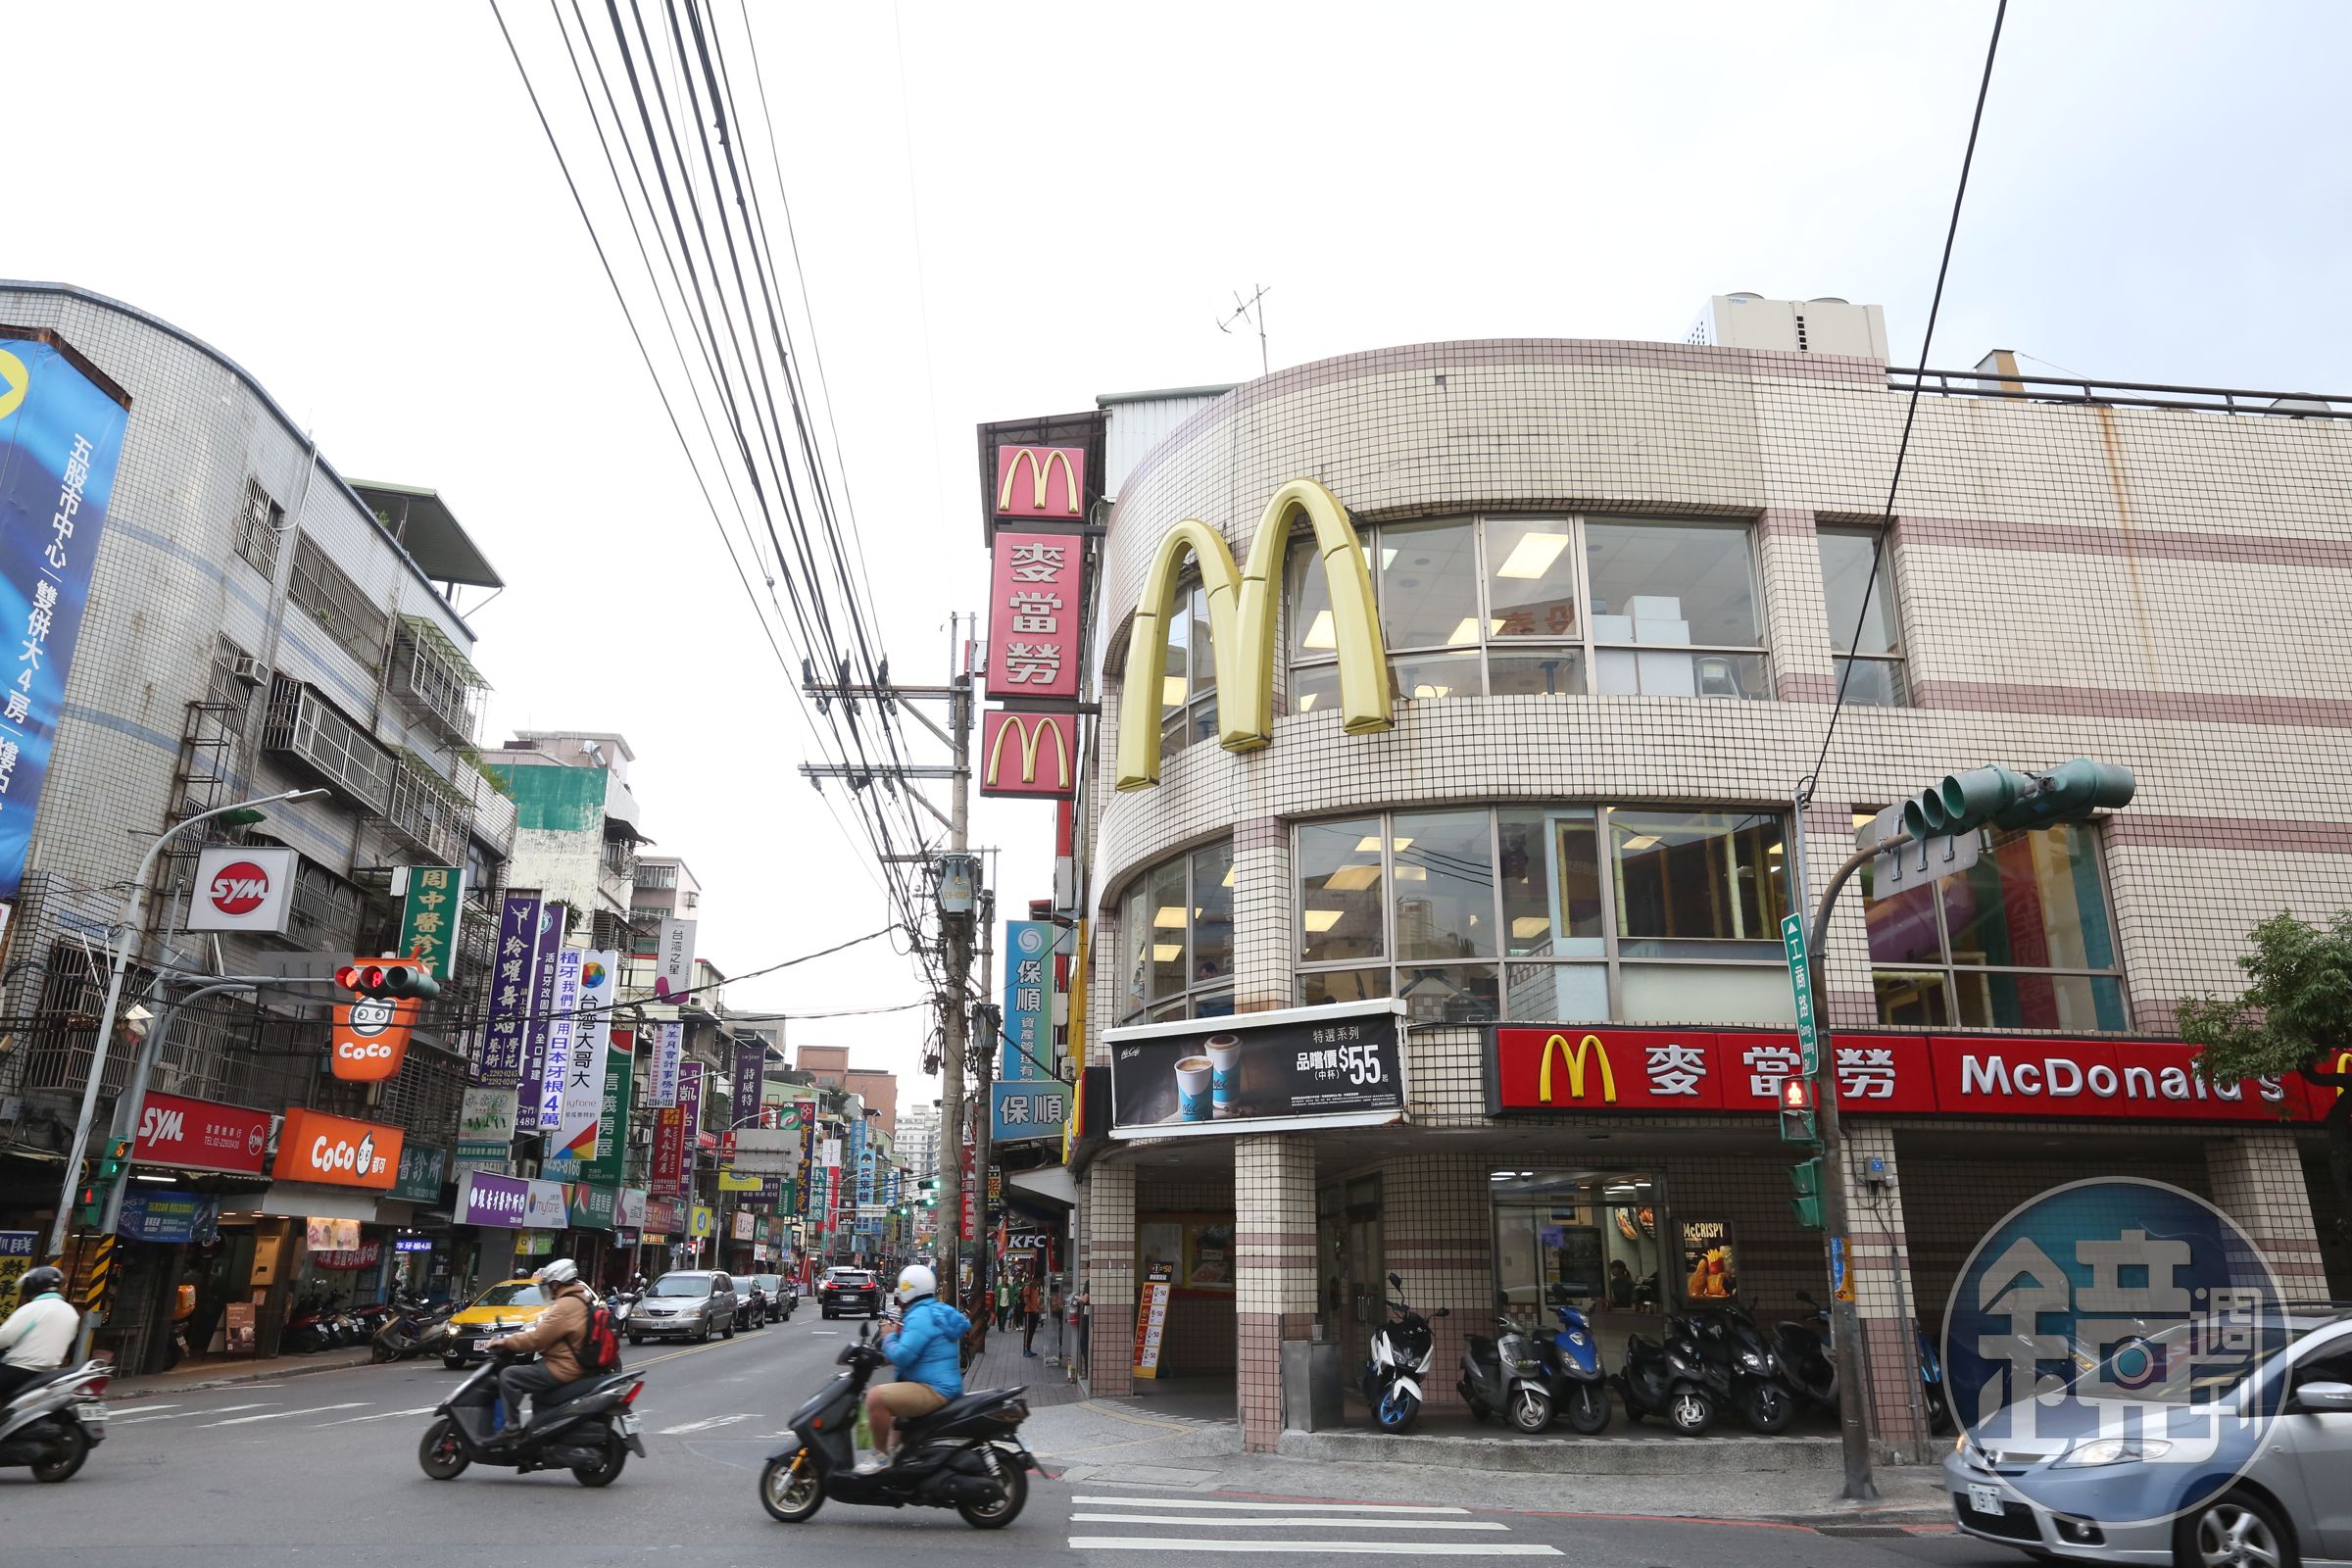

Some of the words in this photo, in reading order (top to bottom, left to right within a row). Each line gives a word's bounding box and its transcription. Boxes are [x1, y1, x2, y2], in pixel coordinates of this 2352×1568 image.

[45, 432, 94, 569] 五股市中心
[1006, 542, 1065, 685] 麥當勞
[4, 579, 58, 725] 雙併大4房
[210, 878, 269, 904] SYM
[1015, 959, 1043, 1012] 保順
[1789, 938, 1808, 1018] 工商路
[338, 1042, 392, 1060] CoCo
[1313, 1025, 1359, 1044] 特選系列
[1339, 1045, 1381, 1085] $55
[1645, 1044, 1896, 1099] 麥當勞
[138, 1106, 184, 1148] SYM
[1000, 1094, 1064, 1125] 保順
[311, 1135, 355, 1172] CoCo
[1008, 1235, 1047, 1248] KFC
[1683, 1222, 1724, 1238] McCRISPY
